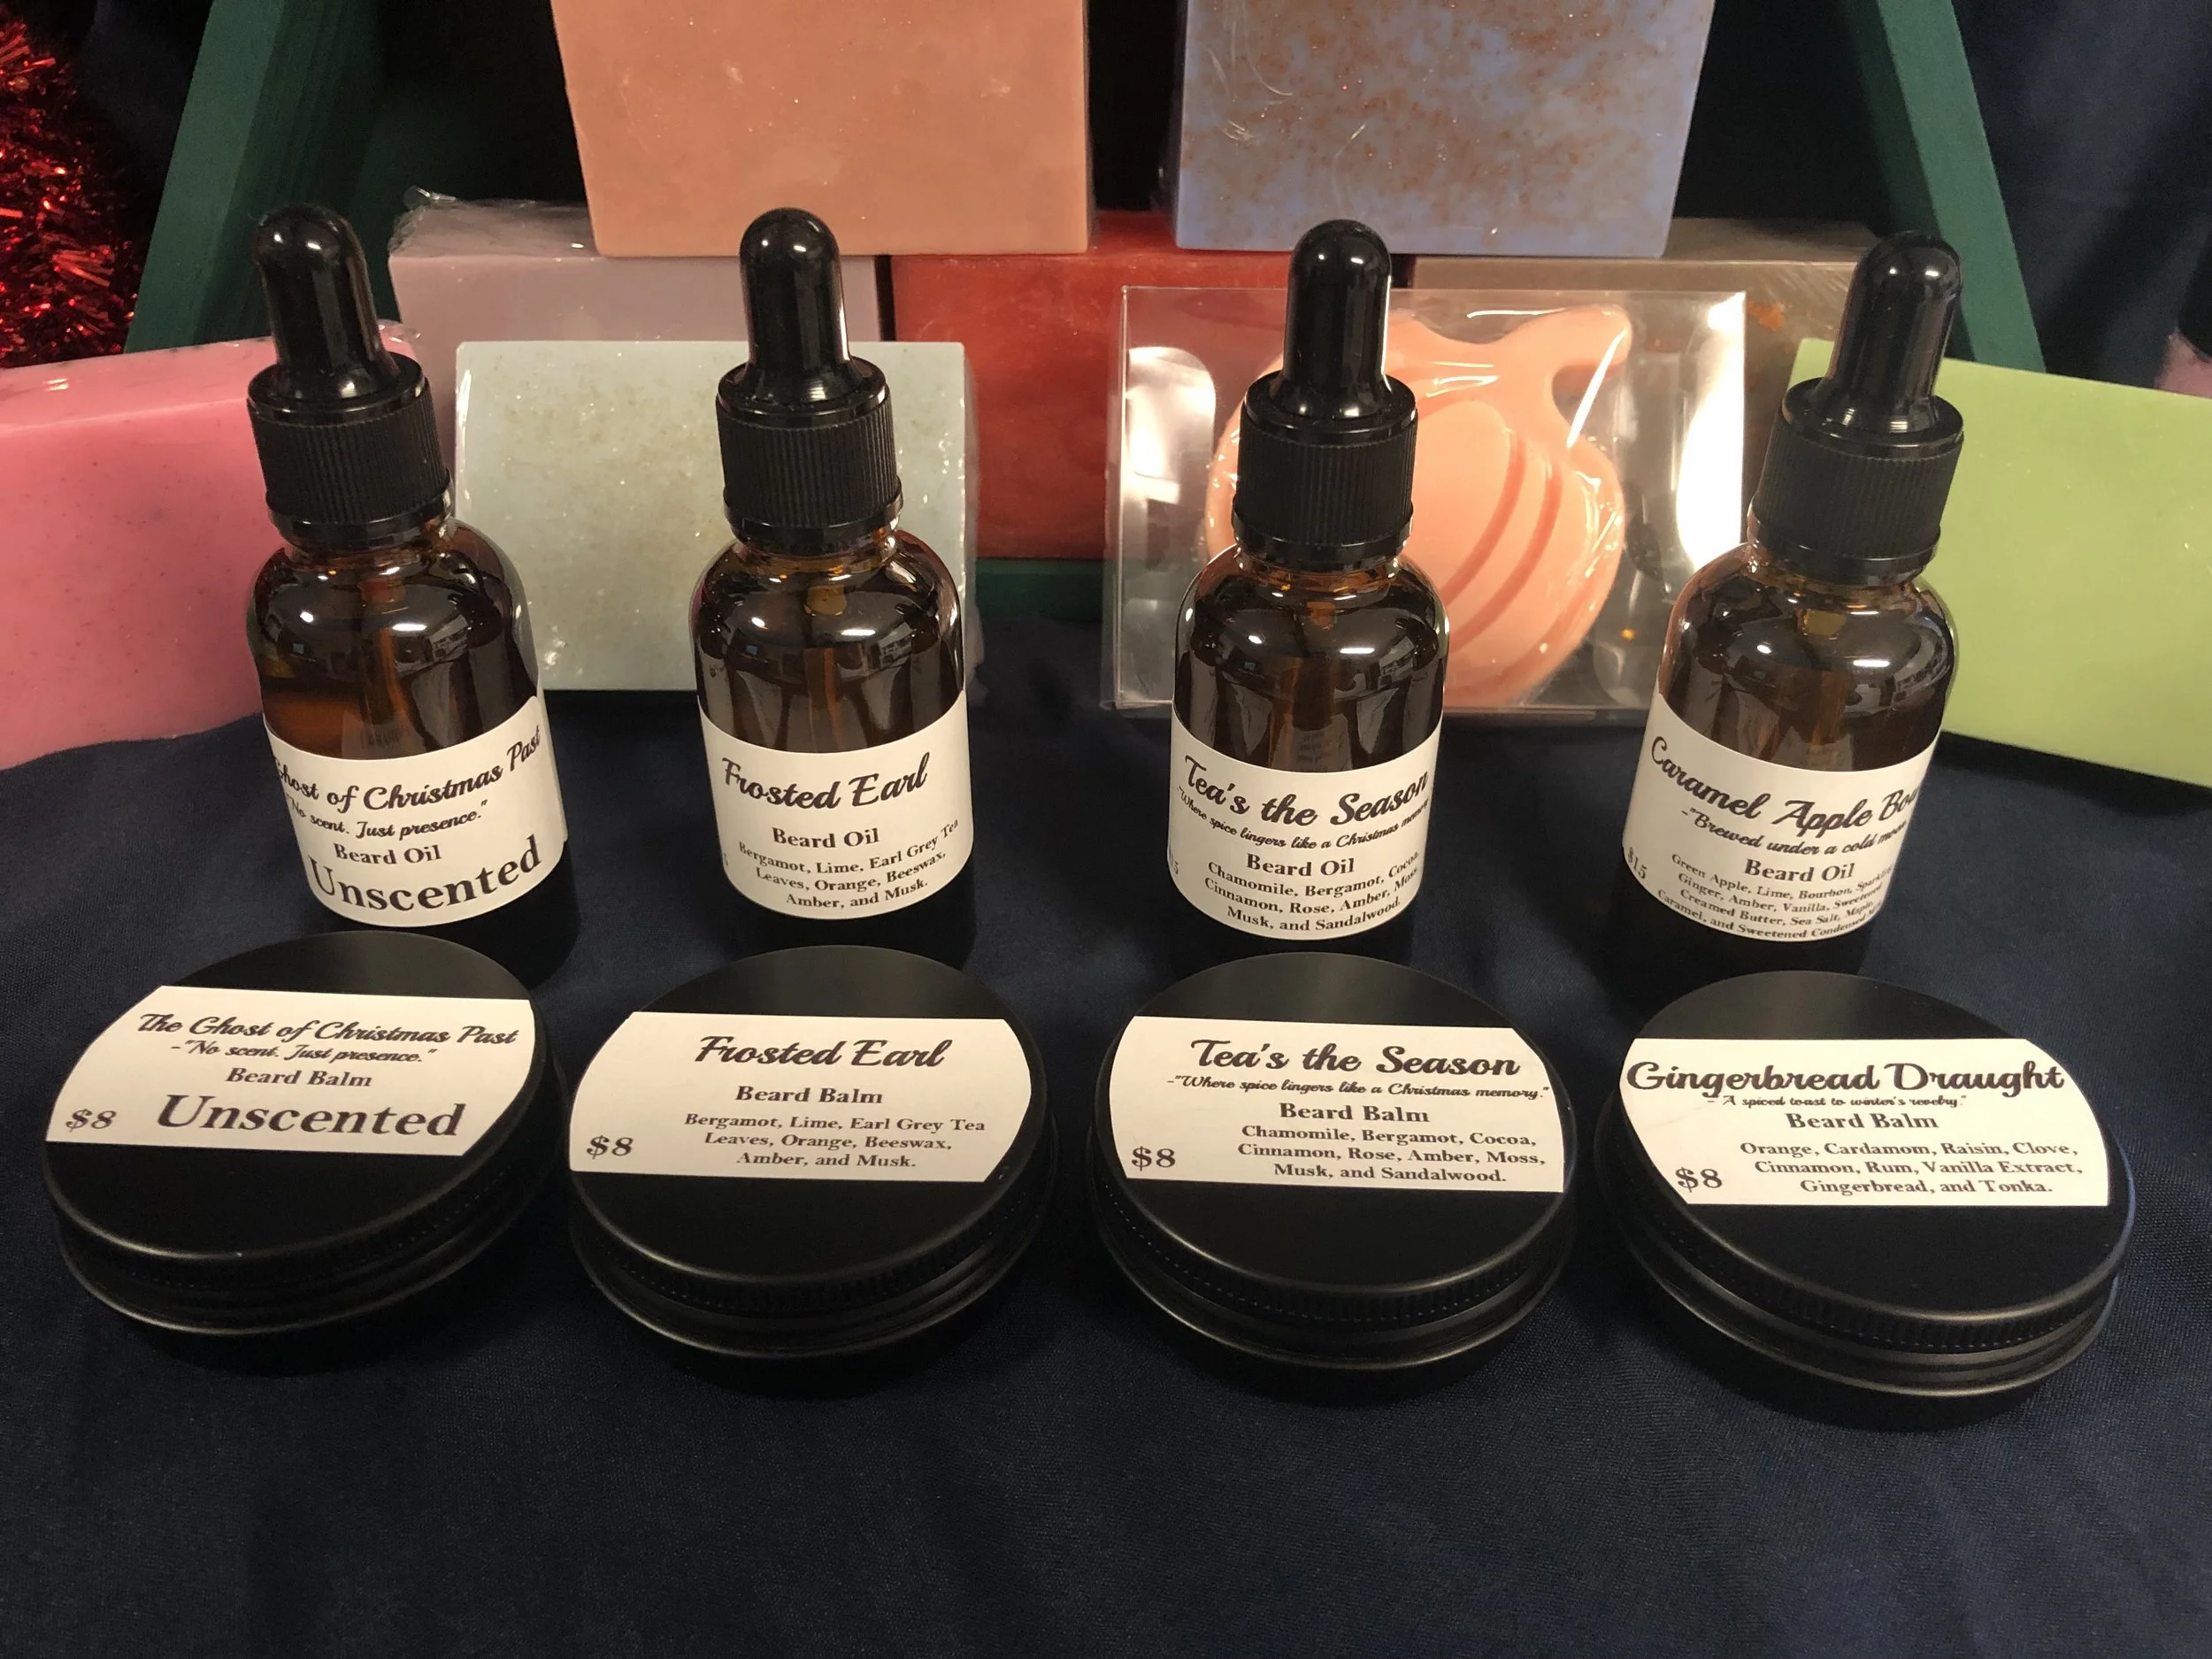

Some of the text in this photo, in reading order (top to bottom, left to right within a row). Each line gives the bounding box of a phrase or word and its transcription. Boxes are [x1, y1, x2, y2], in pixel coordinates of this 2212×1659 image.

[326, 785, 360, 814] of
[363, 764, 503, 810] Christmas
[506, 725, 541, 772] Past
[722, 752, 930, 809] Frosted Earl
[1185, 755, 1428, 826] Tea's the Season
[1651, 735, 1770, 819] Caramel
[1771, 798, 1872, 838] Apple
[311, 814, 349, 833] scent.
[356, 821, 396, 840] Just
[399, 799, 488, 841] presence."
[772, 827, 879, 848] Beard Oil
[1210, 818, 1237, 835] spice
[1240, 826, 1286, 848] lingers
[1291, 837, 1317, 849] like
[1321, 840, 1332, 849] a
[1336, 822, 1399, 848] Christmas
[1766, 841, 1819, 856] under
[1824, 845, 1838, 855] a
[1841, 833, 1876, 854] cold
[334, 842, 442, 864] Beard Oil
[739, 841, 811, 874] Bergamot,
[870, 851, 902, 869] Earl
[906, 836, 938, 858] Grey
[941, 819, 958, 839] Tea
[309, 833, 541, 910] Unscented
[1247, 853, 1355, 877] Beard Oil
[1627, 848, 1647, 879] $15
[1744, 857, 1855, 881] Beard Oil
[756, 867, 810, 891] Leaves,
[814, 878, 881, 893] Orange,
[1209, 862, 1298, 898] Chamomile,
[1305, 873, 1385, 899] Bergamot,
[1671, 853, 1706, 878] Green
[1709, 872, 1752, 894] Apple,
[1756, 885, 1794, 900] Lime,
[786, 880, 928, 909] Amber, and Musk.
[1204, 878, 1283, 913] Cinnamon,
[1289, 900, 1334, 914] Rose,
[1339, 890, 1390, 911] Amber,
[1678, 872, 1724, 901] Ginger,
[1728, 893, 1778, 913] Amber,
[1227, 898, 1401, 931] Musk, and Sandalwood.
[1657, 888, 1708, 922] Caramel,
[1710, 917, 1734, 930] and
[1738, 922, 1807, 939] Sweetened
[1679, 888, 1735, 917] Creamed
[1739, 908, 1786, 926] Butter,
[1789, 917, 1813, 926] Sea
[137, 1013, 521, 1045] The Ghost of Christmas Past
[228, 1045, 281, 1059] scent.
[283, 1045, 330, 1060] Just
[328, 1048, 439, 1064] presence."
[694, 1034, 953, 1068] Frosted Earl
[1190, 1039, 1521, 1076] Tea's the Season
[225, 1067, 372, 1087] Beard Balm
[1239, 1081, 1281, 1094] spice
[1281, 1079, 1334, 1094] lingers
[1339, 1081, 1366, 1094] like
[1371, 1086, 1383, 1094] a
[1387, 1082, 1471, 1097] Christmas
[1625, 1061, 2066, 1099] Gingerbread Draught
[736, 1086, 883, 1104] Beard Balm
[1742, 1096, 1785, 1110] spiced
[1789, 1097, 1826, 1106] toast
[1850, 1096, 1907, 1106] winter's
[66, 1108, 117, 1131] $8
[156, 1094, 468, 1137] Unscented
[684, 1113, 986, 1133] Bergamot, Lime, Earl Grey Tea
[1279, 1102, 1430, 1123] Beard Balm
[1786, 1113, 1941, 1130] Beard Balm
[587, 1134, 634, 1159] $8
[704, 1132, 952, 1151] Leaves, Orange, Beeswax,
[1241, 1125, 1537, 1148] Chamomile, Bergamot, Cocoa,
[736, 1152, 917, 1168] Amber, and Musk.
[1131, 1148, 1177, 1171] $8
[1238, 1143, 1546, 1167] Cinnamon, Rose, Amber, Moss,
[1740, 1142, 2078, 1158] Orange, Cardamom, Raisin, Clove,
[1273, 1164, 1507, 1183] Musk, and Sandalwood.
[1676, 1167, 1723, 1191] $8
[1755, 1160, 2083, 1176] Cinnamon, Rum, Vanilla Extract,
[1800, 1179, 2054, 1197] Gingerbread, and Tonka.
